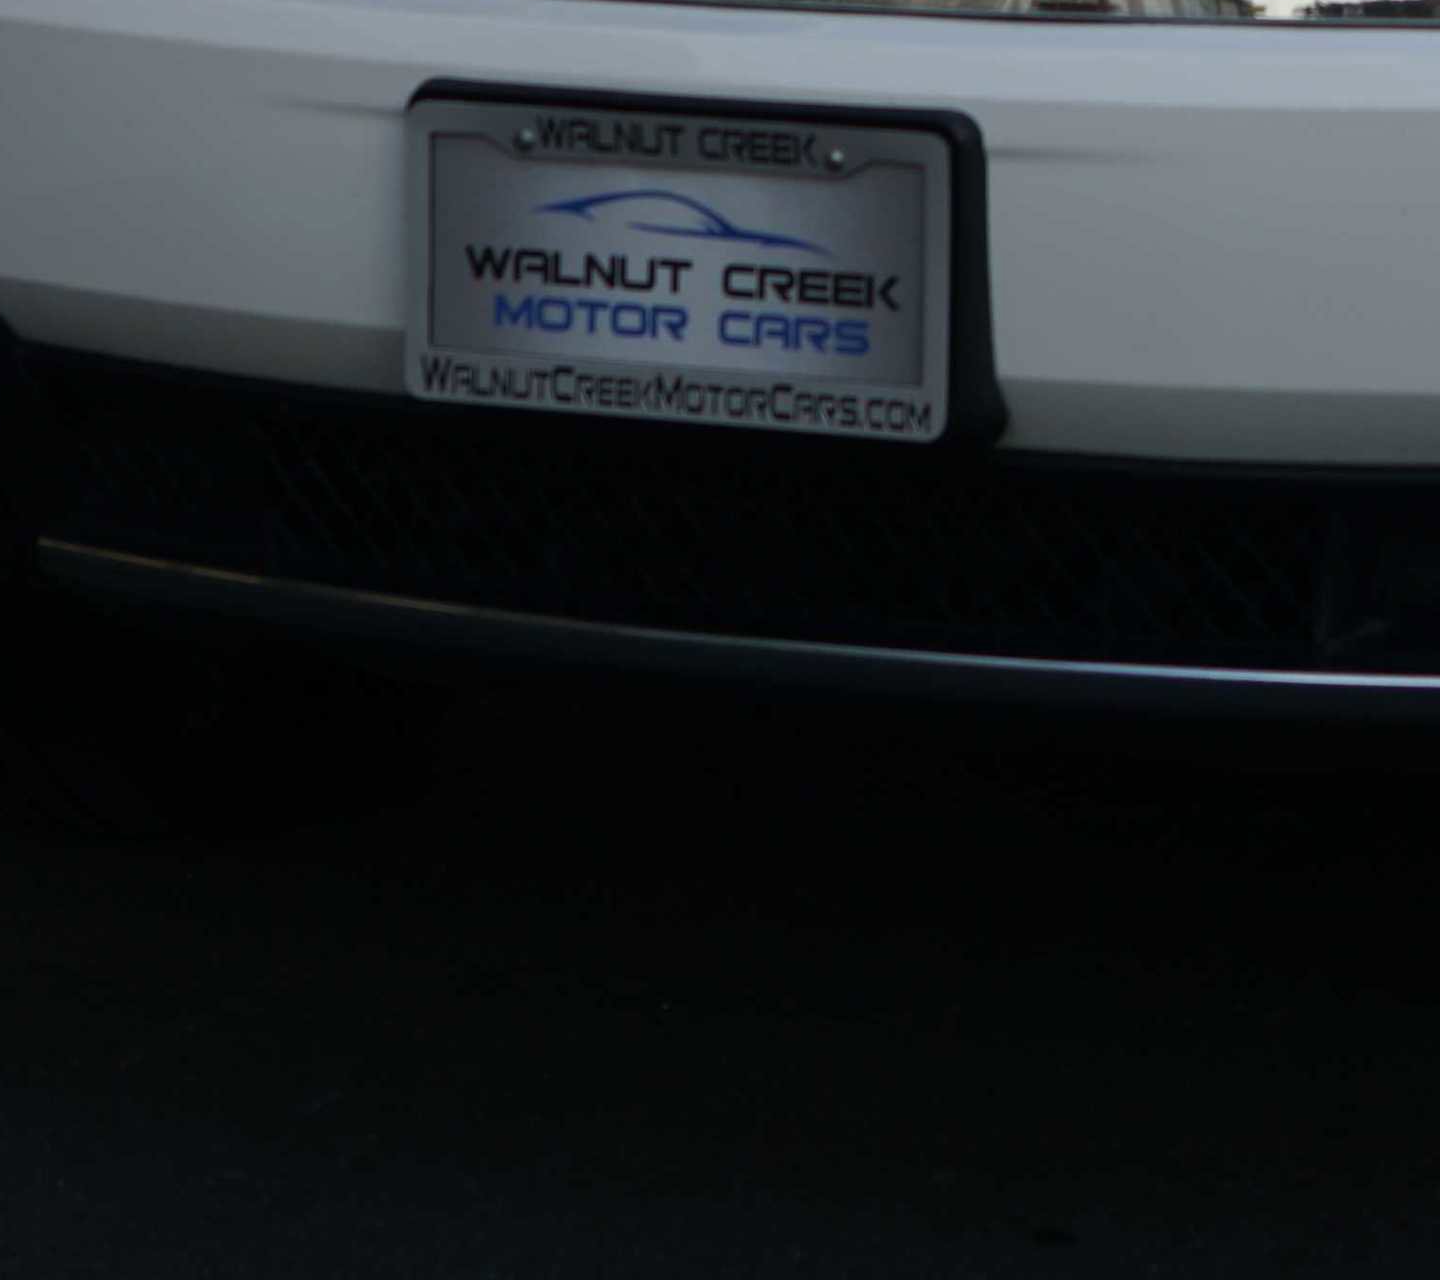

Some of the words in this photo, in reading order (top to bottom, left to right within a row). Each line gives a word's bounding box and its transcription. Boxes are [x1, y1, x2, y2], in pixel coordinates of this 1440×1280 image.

[536, 115, 685, 157] WALNUT
[697, 125, 818, 168] CREEK
[465, 244, 692, 293] WALNUT
[721, 263, 901, 312] CREEK
[492, 294, 689, 341] MOTOR
[717, 311, 872, 357] CARS
